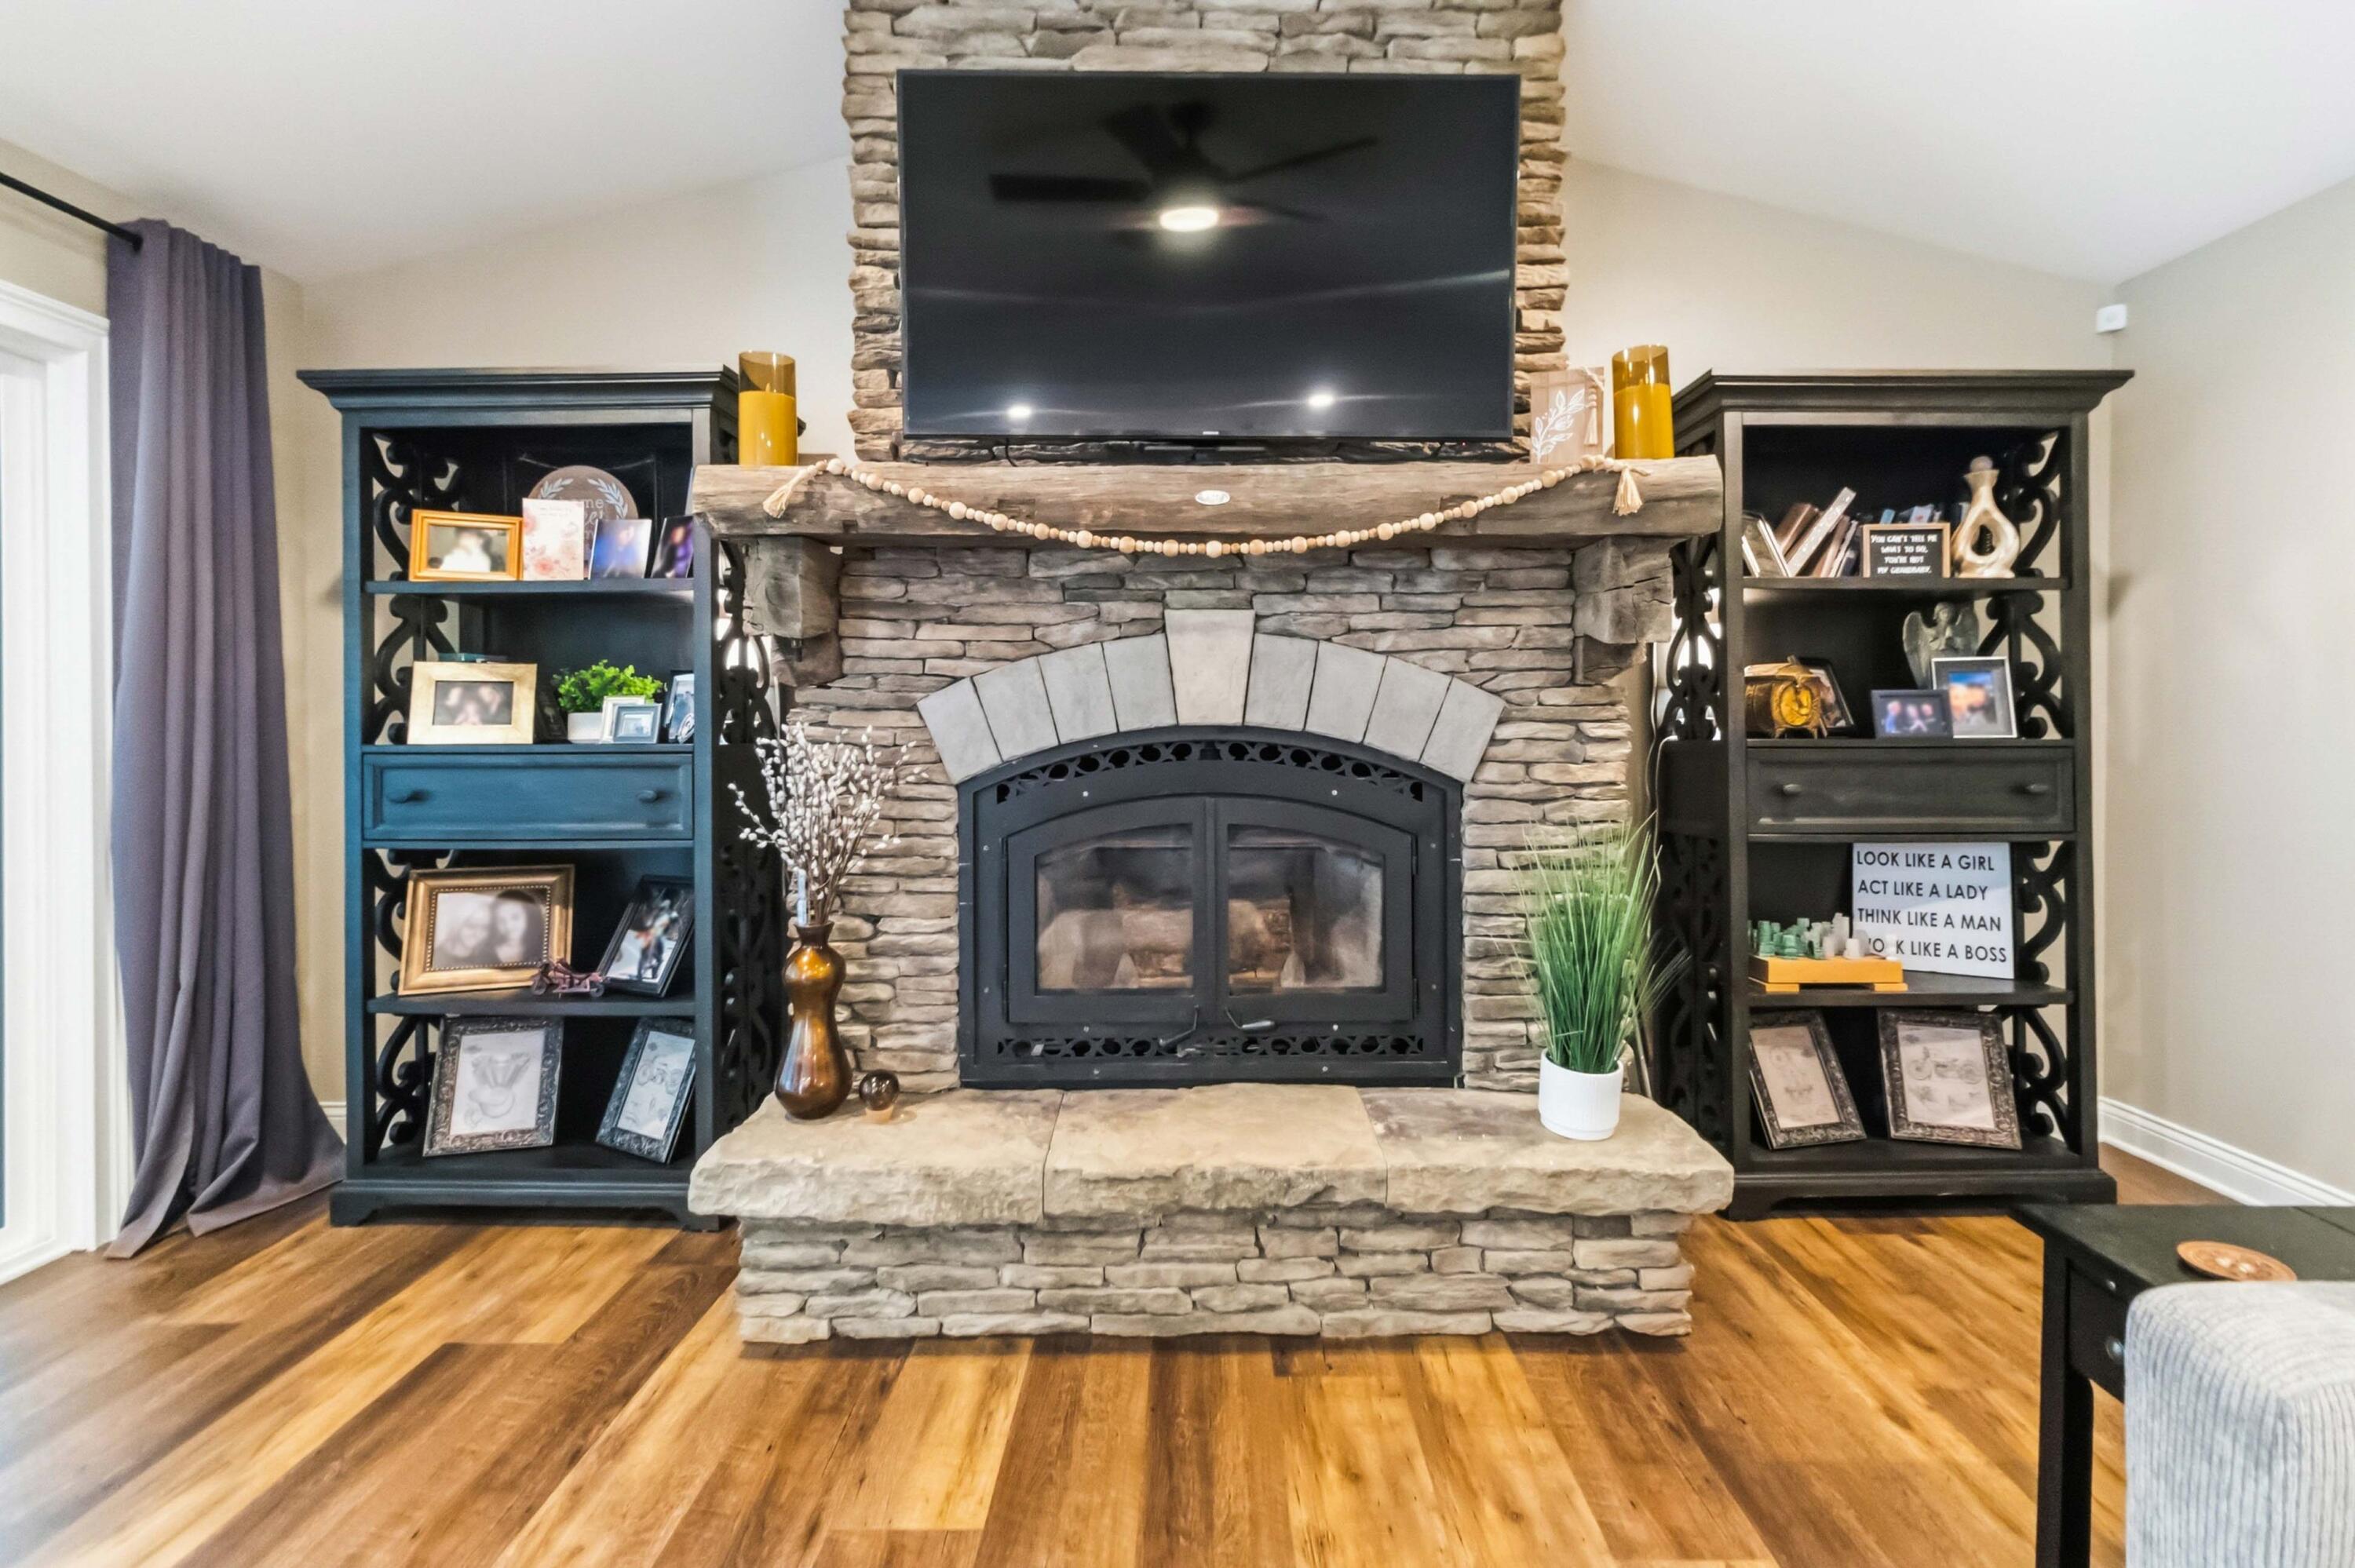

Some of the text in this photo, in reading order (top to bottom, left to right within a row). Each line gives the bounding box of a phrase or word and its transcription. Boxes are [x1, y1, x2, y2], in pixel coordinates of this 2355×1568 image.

[1871, 534, 1886, 543] YOU
[1857, 851, 1995, 871] LOOK LIKE A GIRL
[1857, 879, 1988, 900] ACT LIKE A LADY
[1857, 908, 2002, 932] THINK LIKE A MAN
[1867, 938, 2006, 963] OK LIKE A BOSS
